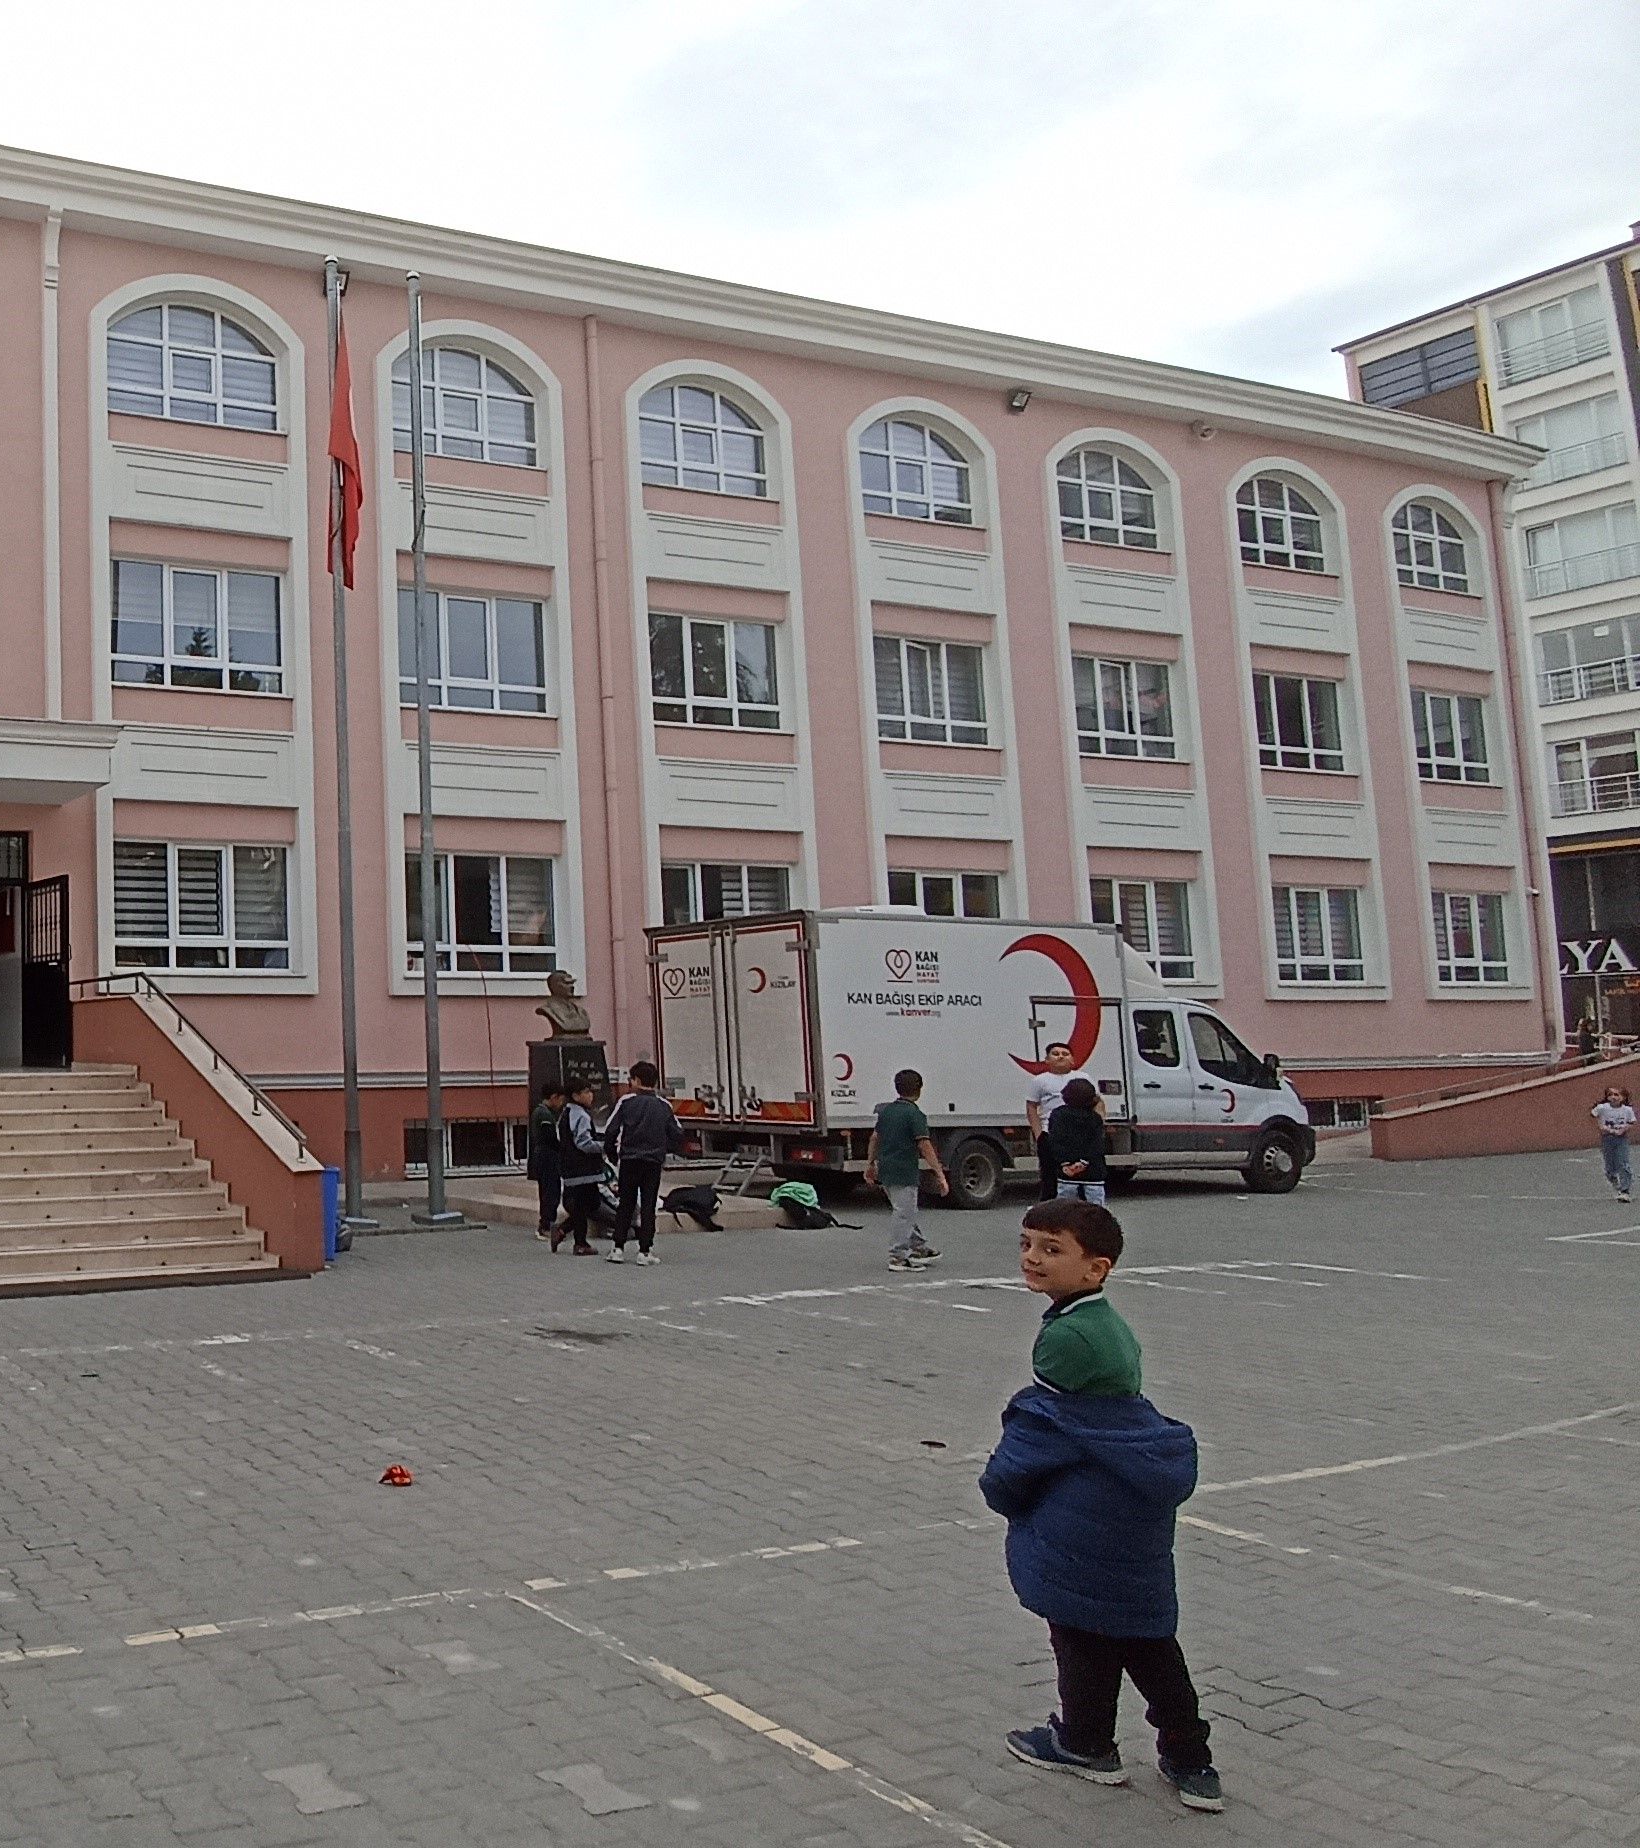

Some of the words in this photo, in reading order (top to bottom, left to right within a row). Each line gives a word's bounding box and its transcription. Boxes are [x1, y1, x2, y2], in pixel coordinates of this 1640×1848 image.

[915, 951, 938, 962] KAN
[1560, 938, 1638, 975] YA
[689, 966, 710, 978] KAN
[847, 992, 872, 1005] KAN
[876, 991, 915, 1007] BAĞIŞI
[918, 993, 945, 1006] EKİP
[947, 995, 982, 1007] ARACI
